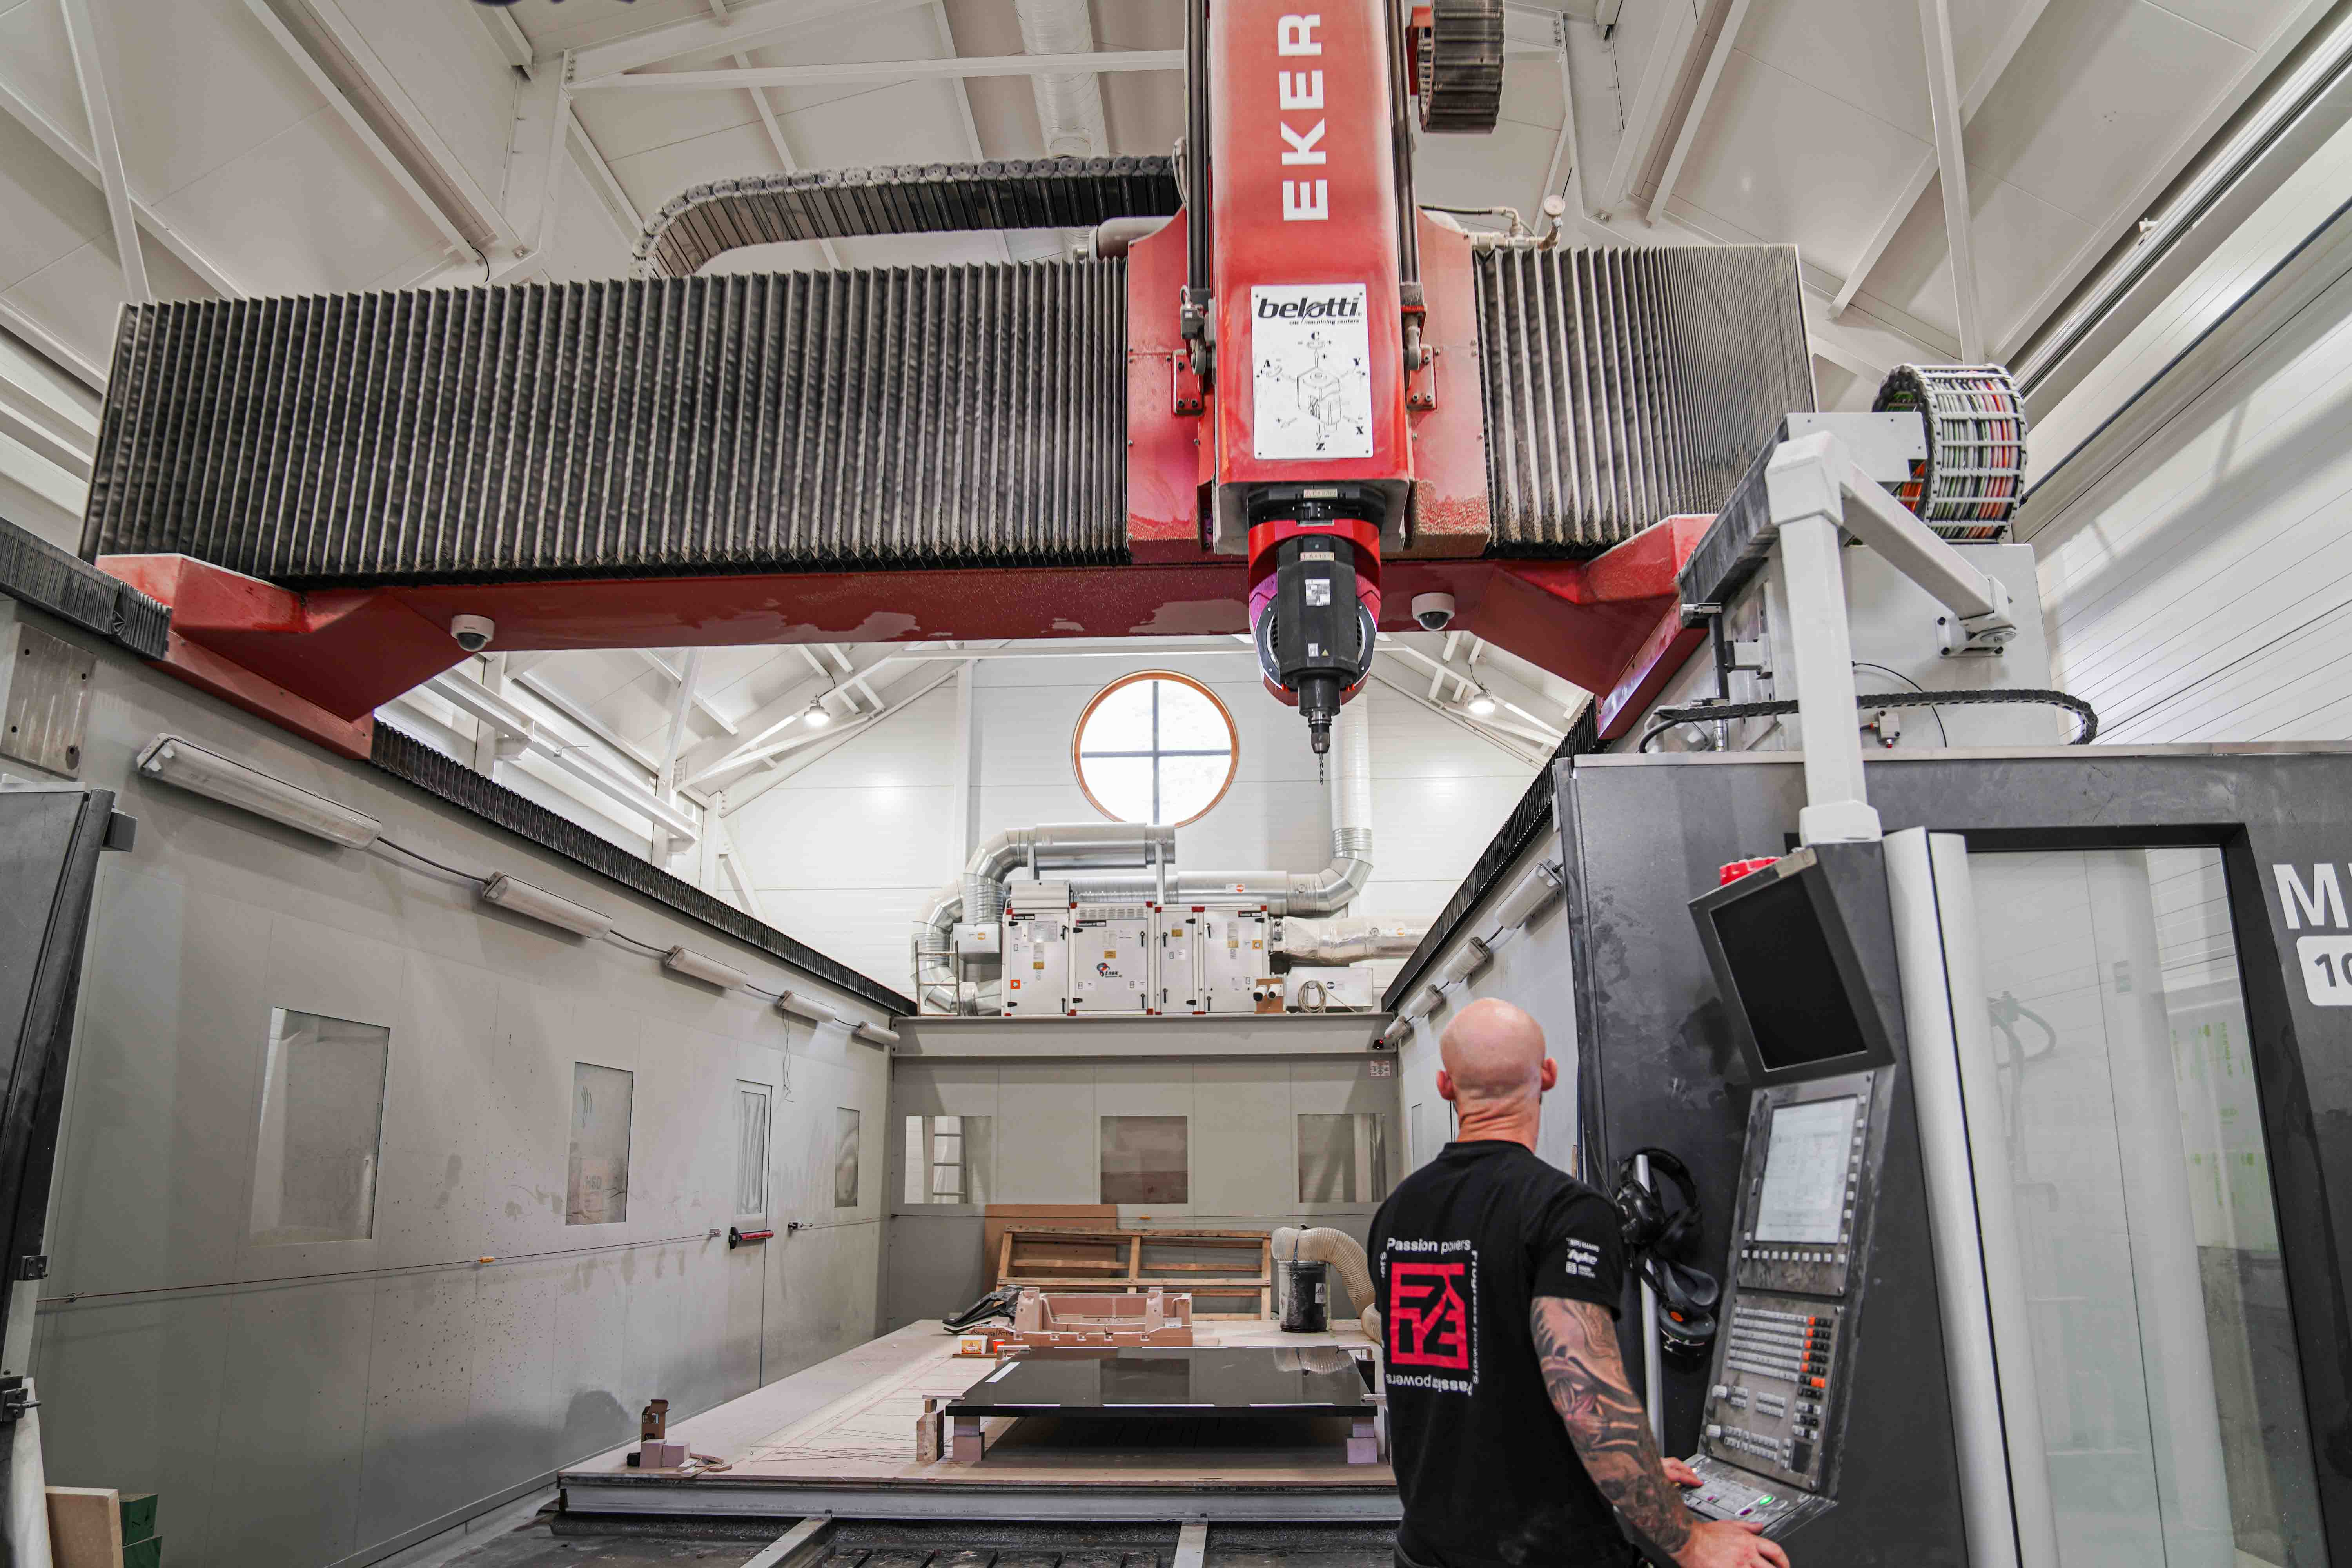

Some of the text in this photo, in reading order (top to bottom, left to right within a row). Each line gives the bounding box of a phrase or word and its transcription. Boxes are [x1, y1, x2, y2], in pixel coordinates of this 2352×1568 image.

[1278, 14, 1328, 221] EKER
[1258, 296, 1359, 319] belotti
[1311, 331, 1320, 340] C
[1263, 359, 1270, 368] A
[1353, 357, 1361, 366] Y
[1356, 426, 1364, 435] X
[1316, 443, 1325, 451] Z
[2272, 863, 2352, 930] M
[1387, 1237, 1438, 1252] Passion
[1386, 1373, 1431, 1388] powers
